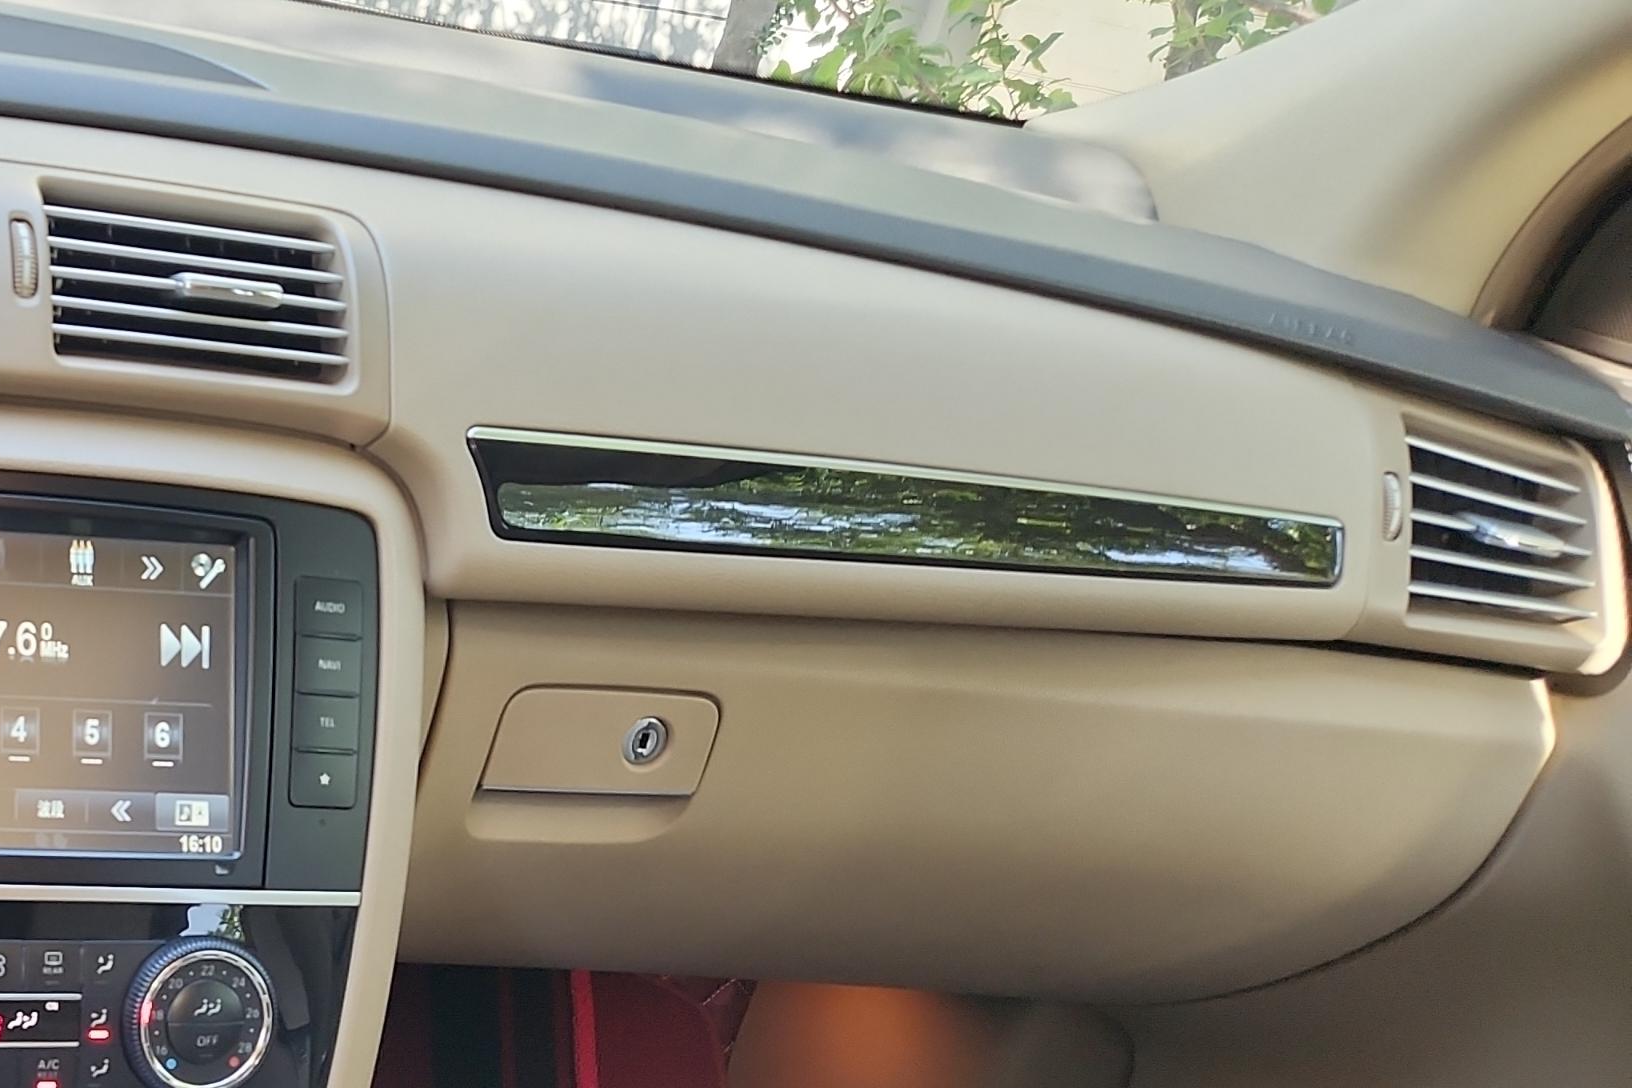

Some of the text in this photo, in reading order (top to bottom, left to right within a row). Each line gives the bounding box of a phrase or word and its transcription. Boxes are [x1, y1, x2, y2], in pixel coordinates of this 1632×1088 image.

[314, 600, 346, 614] AUDIO
[318, 658, 342, 671] NAVI
[320, 716, 336, 729] TEL
[10, 715, 28, 743] 4
[84, 718, 100, 746] 5
[154, 721, 171, 748] 6
[179, 834, 223, 854] 16:10
[200, 965, 216, 977] 22
[168, 978, 184, 990] 20
[231, 977, 246, 989] 24
[245, 1008, 260, 1019] 26
[196, 1035, 219, 1047] OFF
[237, 1042, 253, 1054] 28
[37, 1058, 60, 1070] A/C
